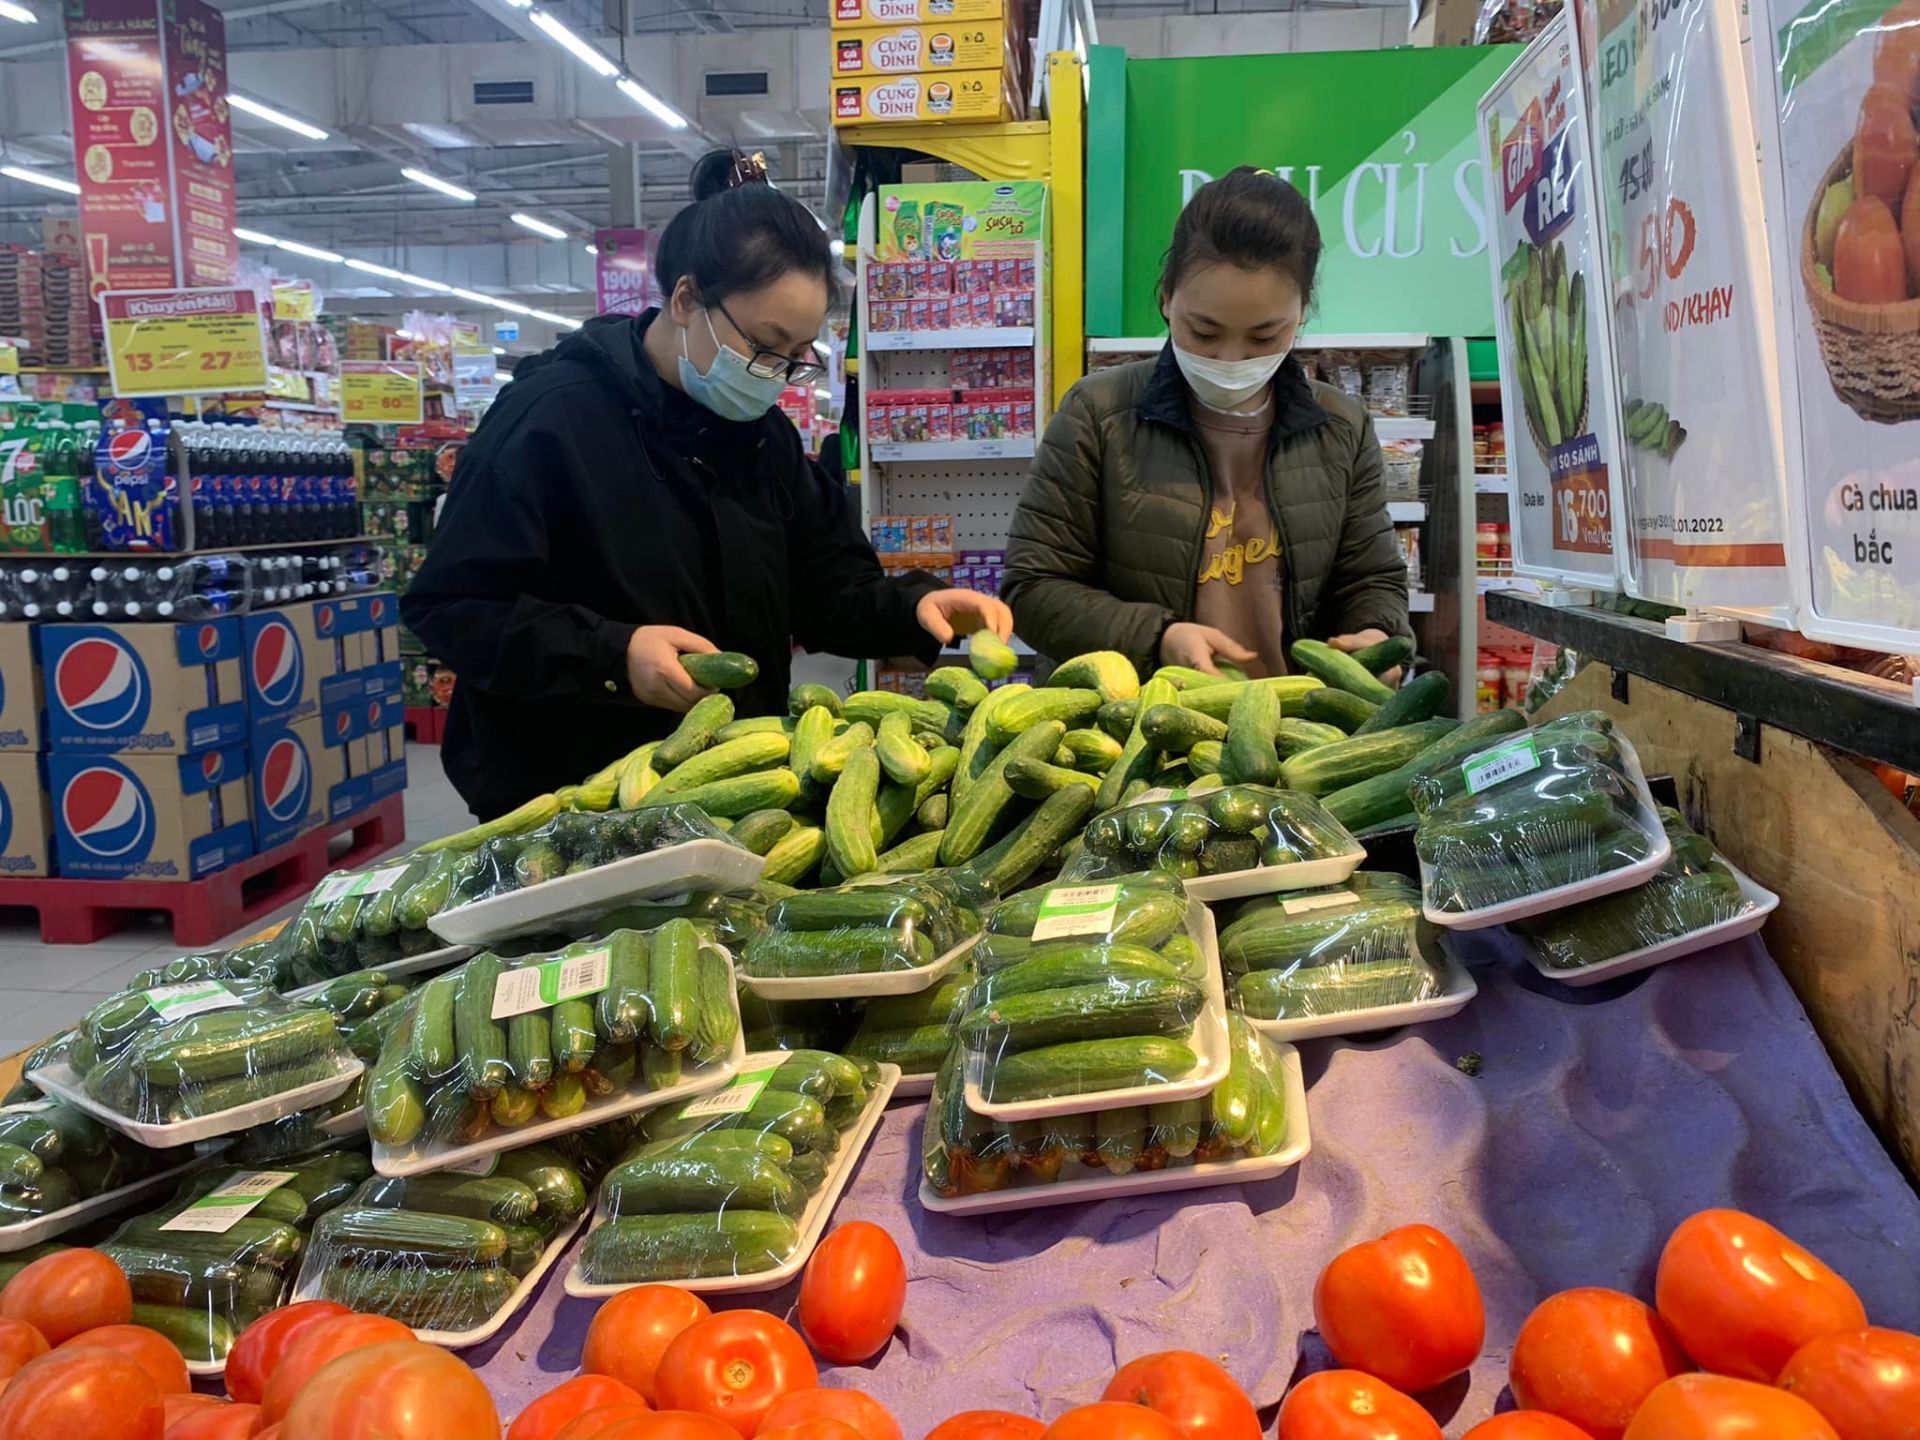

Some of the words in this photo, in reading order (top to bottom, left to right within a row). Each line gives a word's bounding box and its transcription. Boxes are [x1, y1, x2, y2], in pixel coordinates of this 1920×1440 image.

[878, 40, 917, 54] CUNG
[876, 88, 916, 101] CUNG
[1342, 130, 1429, 259] CỦ
[602, 271, 643, 290] 1900
[124, 352, 153, 372] 13
[201, 351, 232, 371] 27
[114, 475, 149, 487] pepsi
[1841, 485, 1863, 511] Cà
[1869, 483, 1918, 511] chua
[1854, 528, 1892, 564] bắc
[129, 731, 174, 749] pepsi
